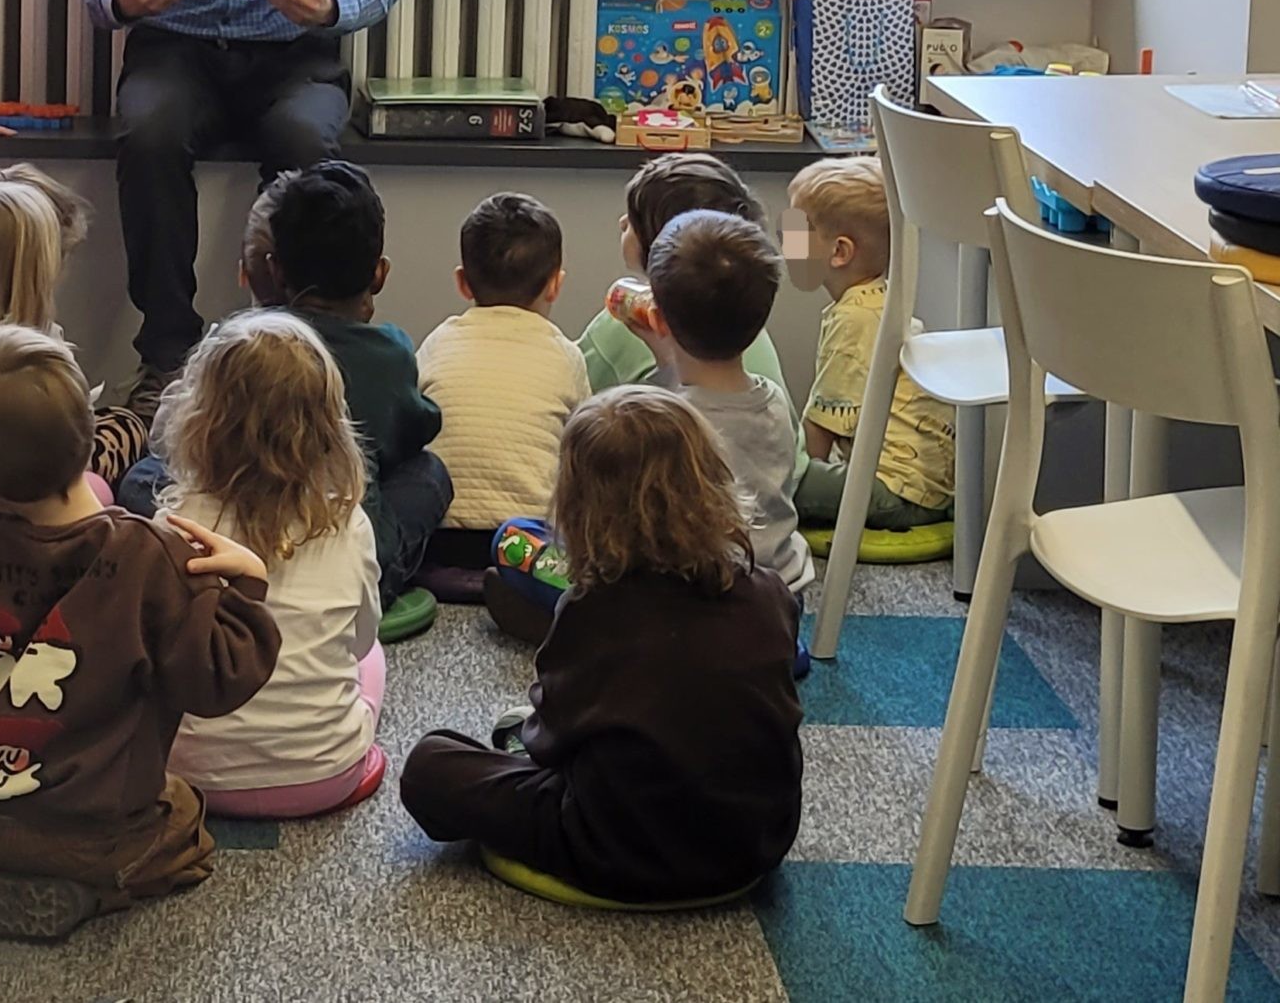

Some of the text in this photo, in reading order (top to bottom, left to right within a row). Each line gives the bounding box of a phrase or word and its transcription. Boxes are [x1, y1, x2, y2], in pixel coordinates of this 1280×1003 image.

[608, 24, 649, 35] KOSMOS
[926, 43, 958, 52] PUCO
[469, 114, 482, 125] 6
[518, 108, 533, 133] S-Z
